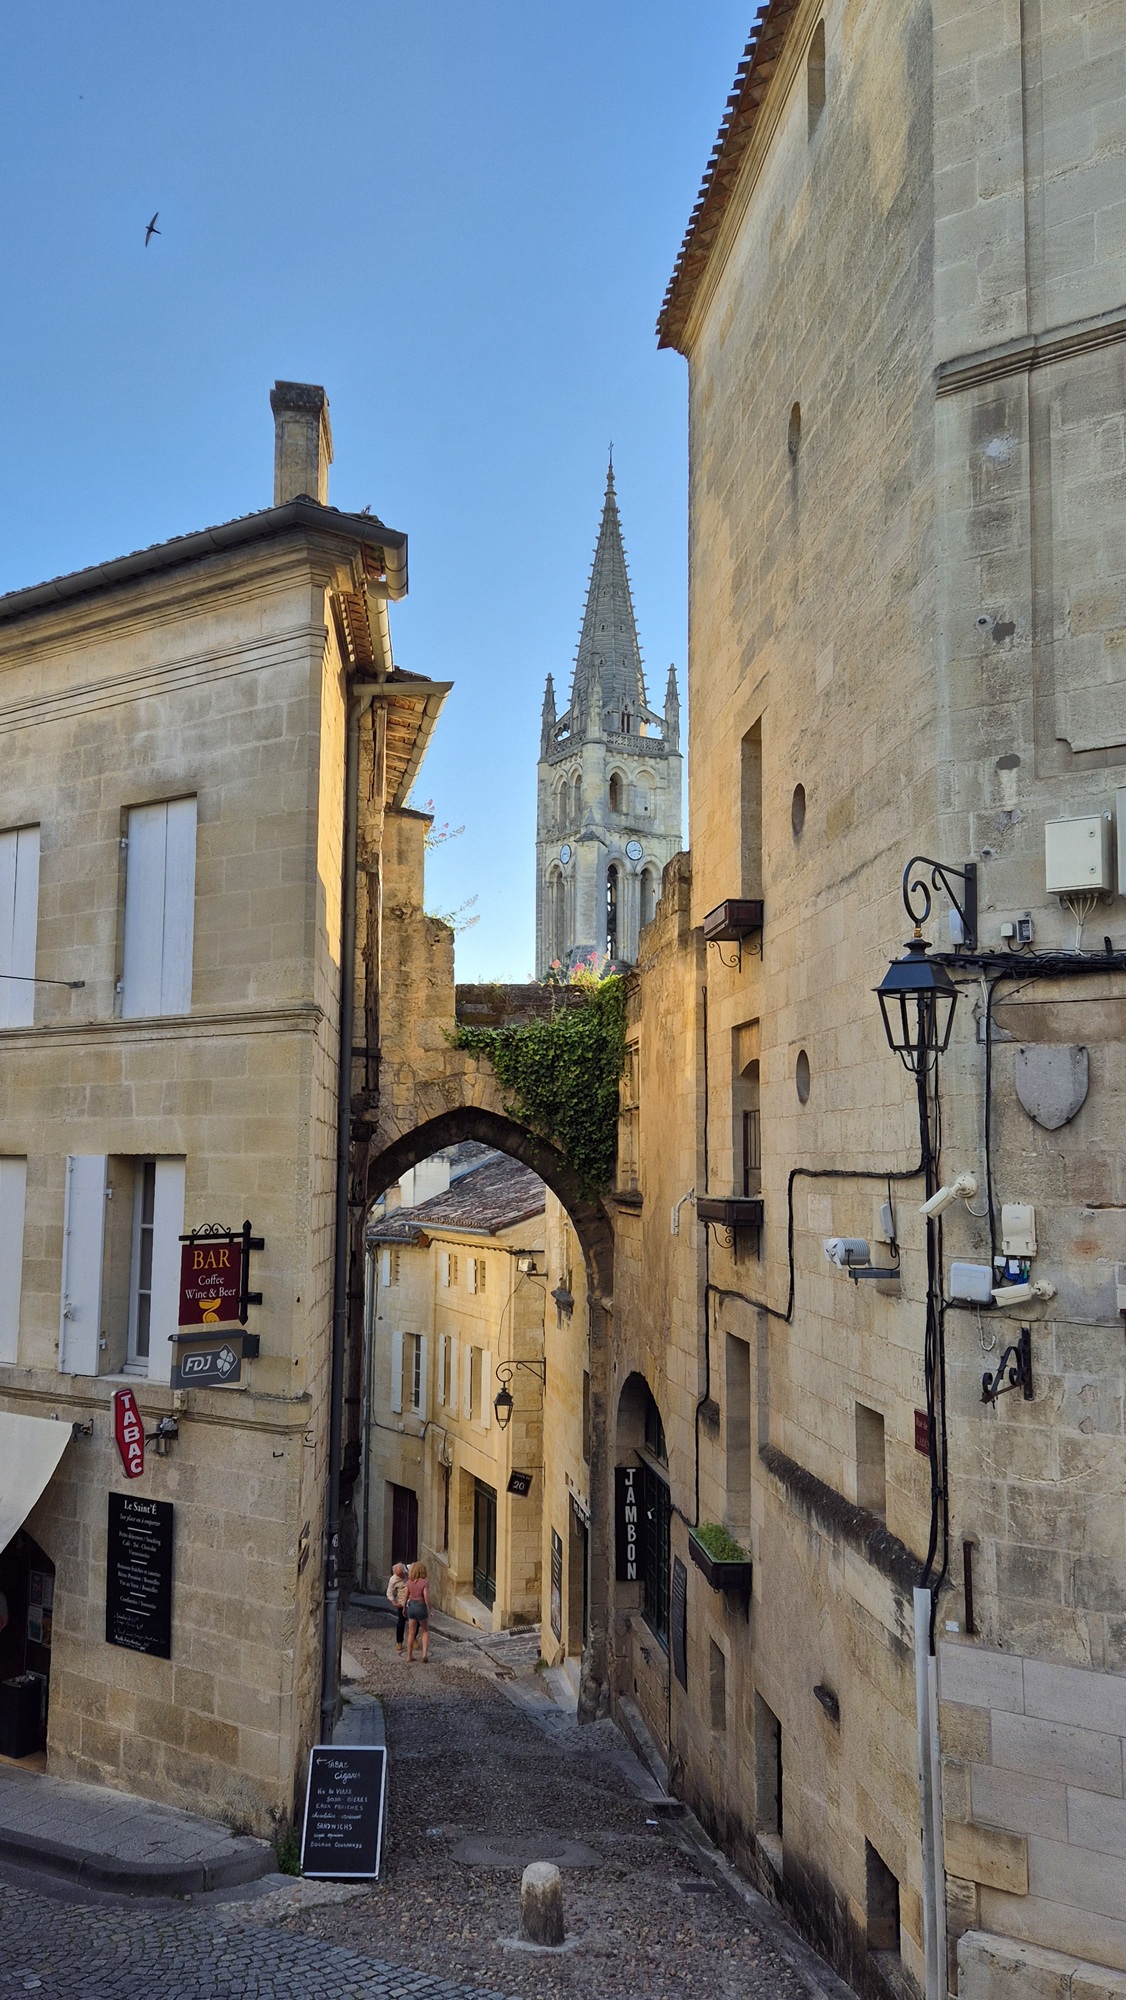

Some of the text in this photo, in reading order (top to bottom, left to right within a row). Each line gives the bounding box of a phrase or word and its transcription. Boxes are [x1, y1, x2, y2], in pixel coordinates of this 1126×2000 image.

[192, 1249, 231, 1270] BAR
[198, 1274, 225, 1286] Coffee
[185, 1287, 236, 1299] Wine & Beer
[185, 1356, 212, 1372] FDJ
[121, 1395, 142, 1474] TABAC
[513, 1480, 525, 1491] 20
[124, 1500, 132, 1510] Le
[625, 1468, 637, 1580] JAMBON
[325, 1759, 349, 1768] TABAC
